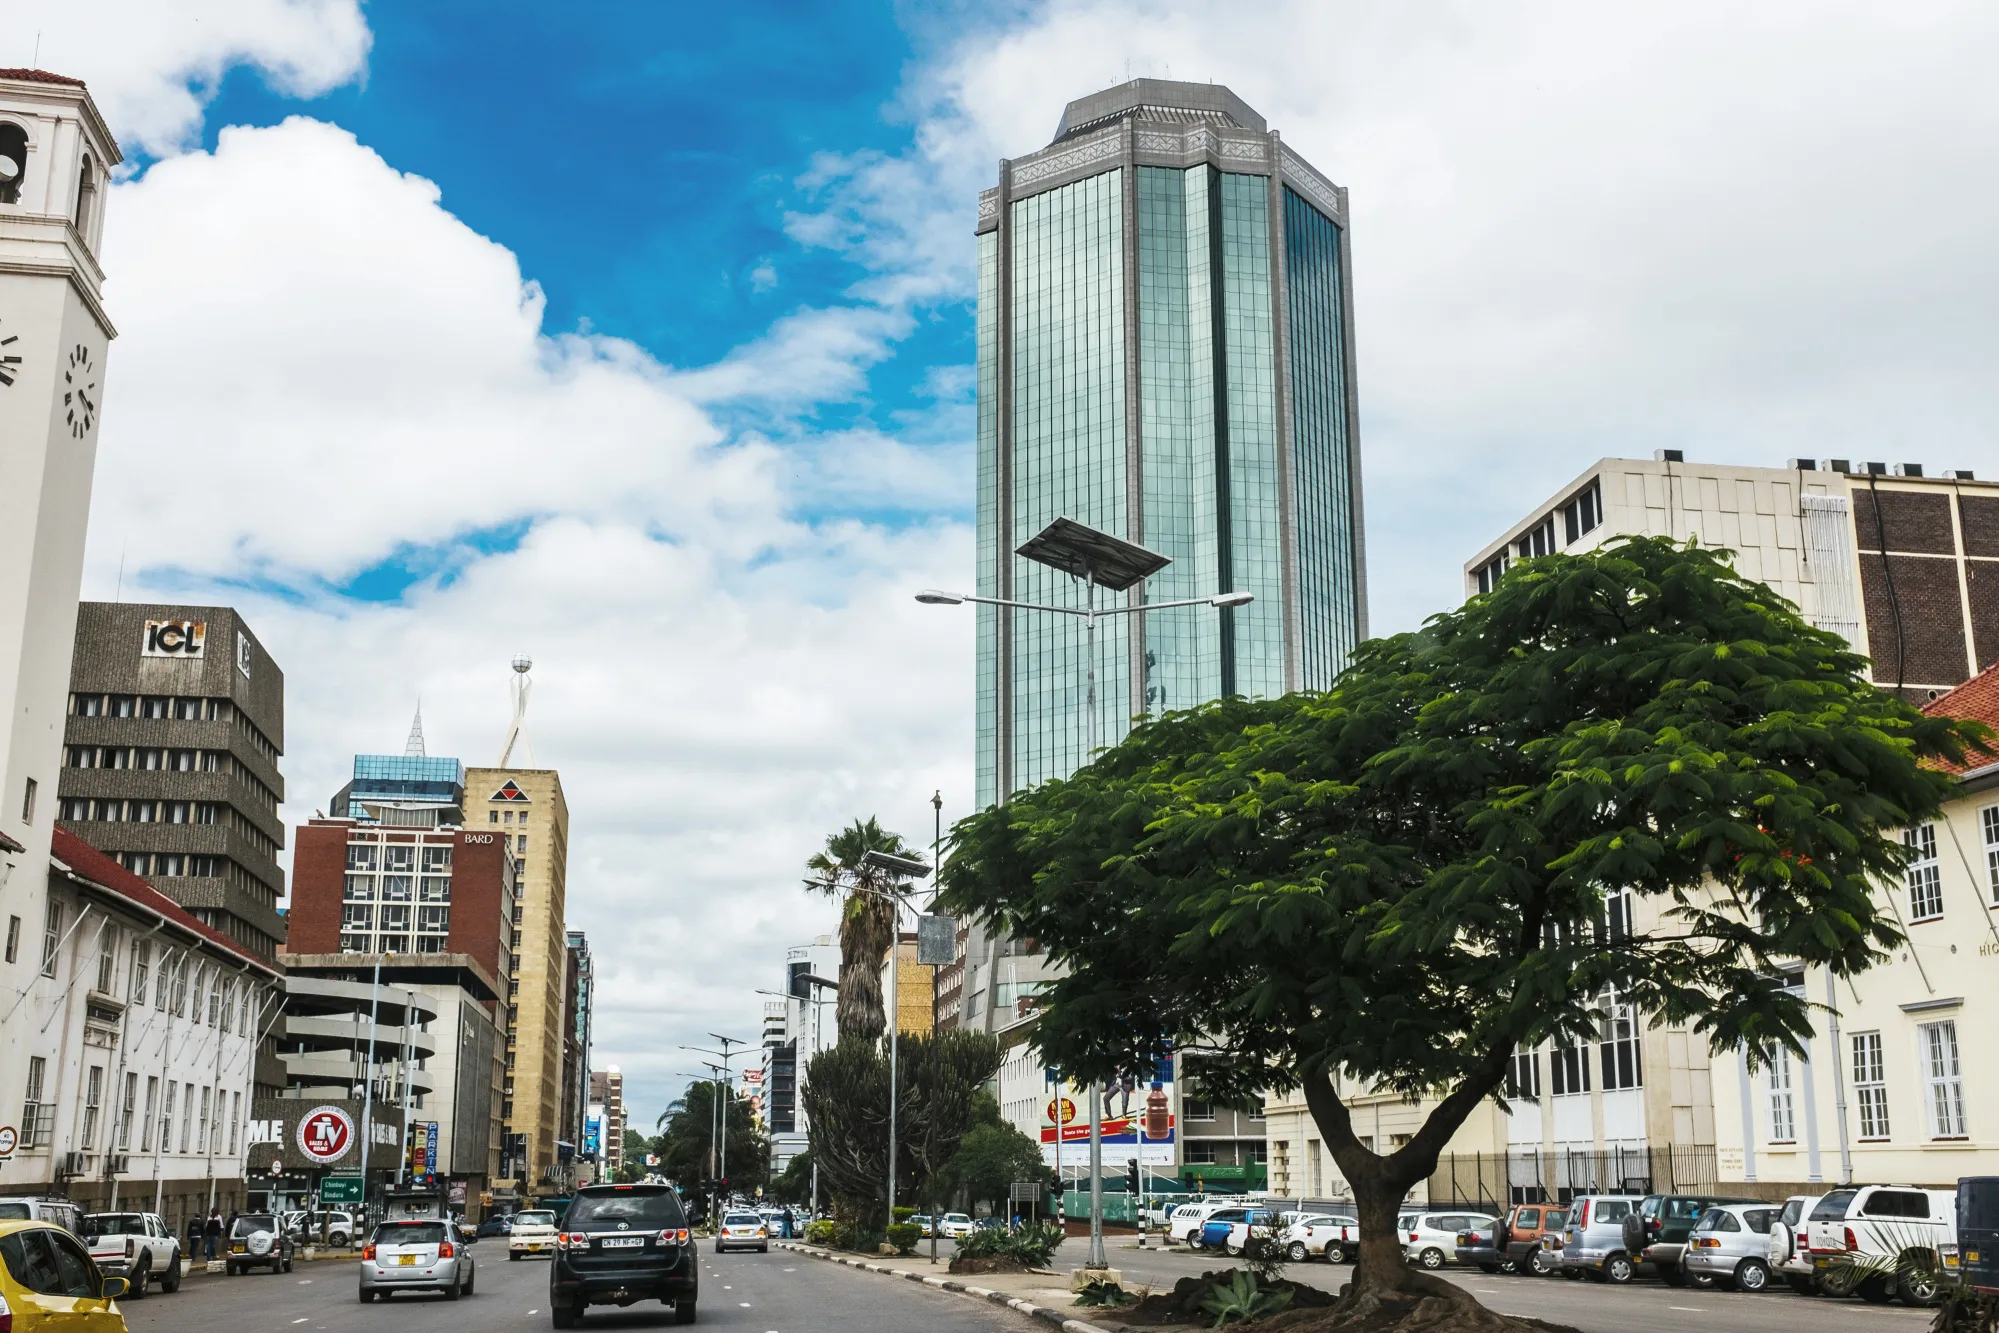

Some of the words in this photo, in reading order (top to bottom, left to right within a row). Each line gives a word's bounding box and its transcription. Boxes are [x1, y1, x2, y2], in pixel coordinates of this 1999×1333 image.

[148, 625, 201, 653] ICL
[465, 834, 494, 844] BARD
[312, 1116, 344, 1149] TV
[1816, 1236, 1837, 1248] TOYOTA
